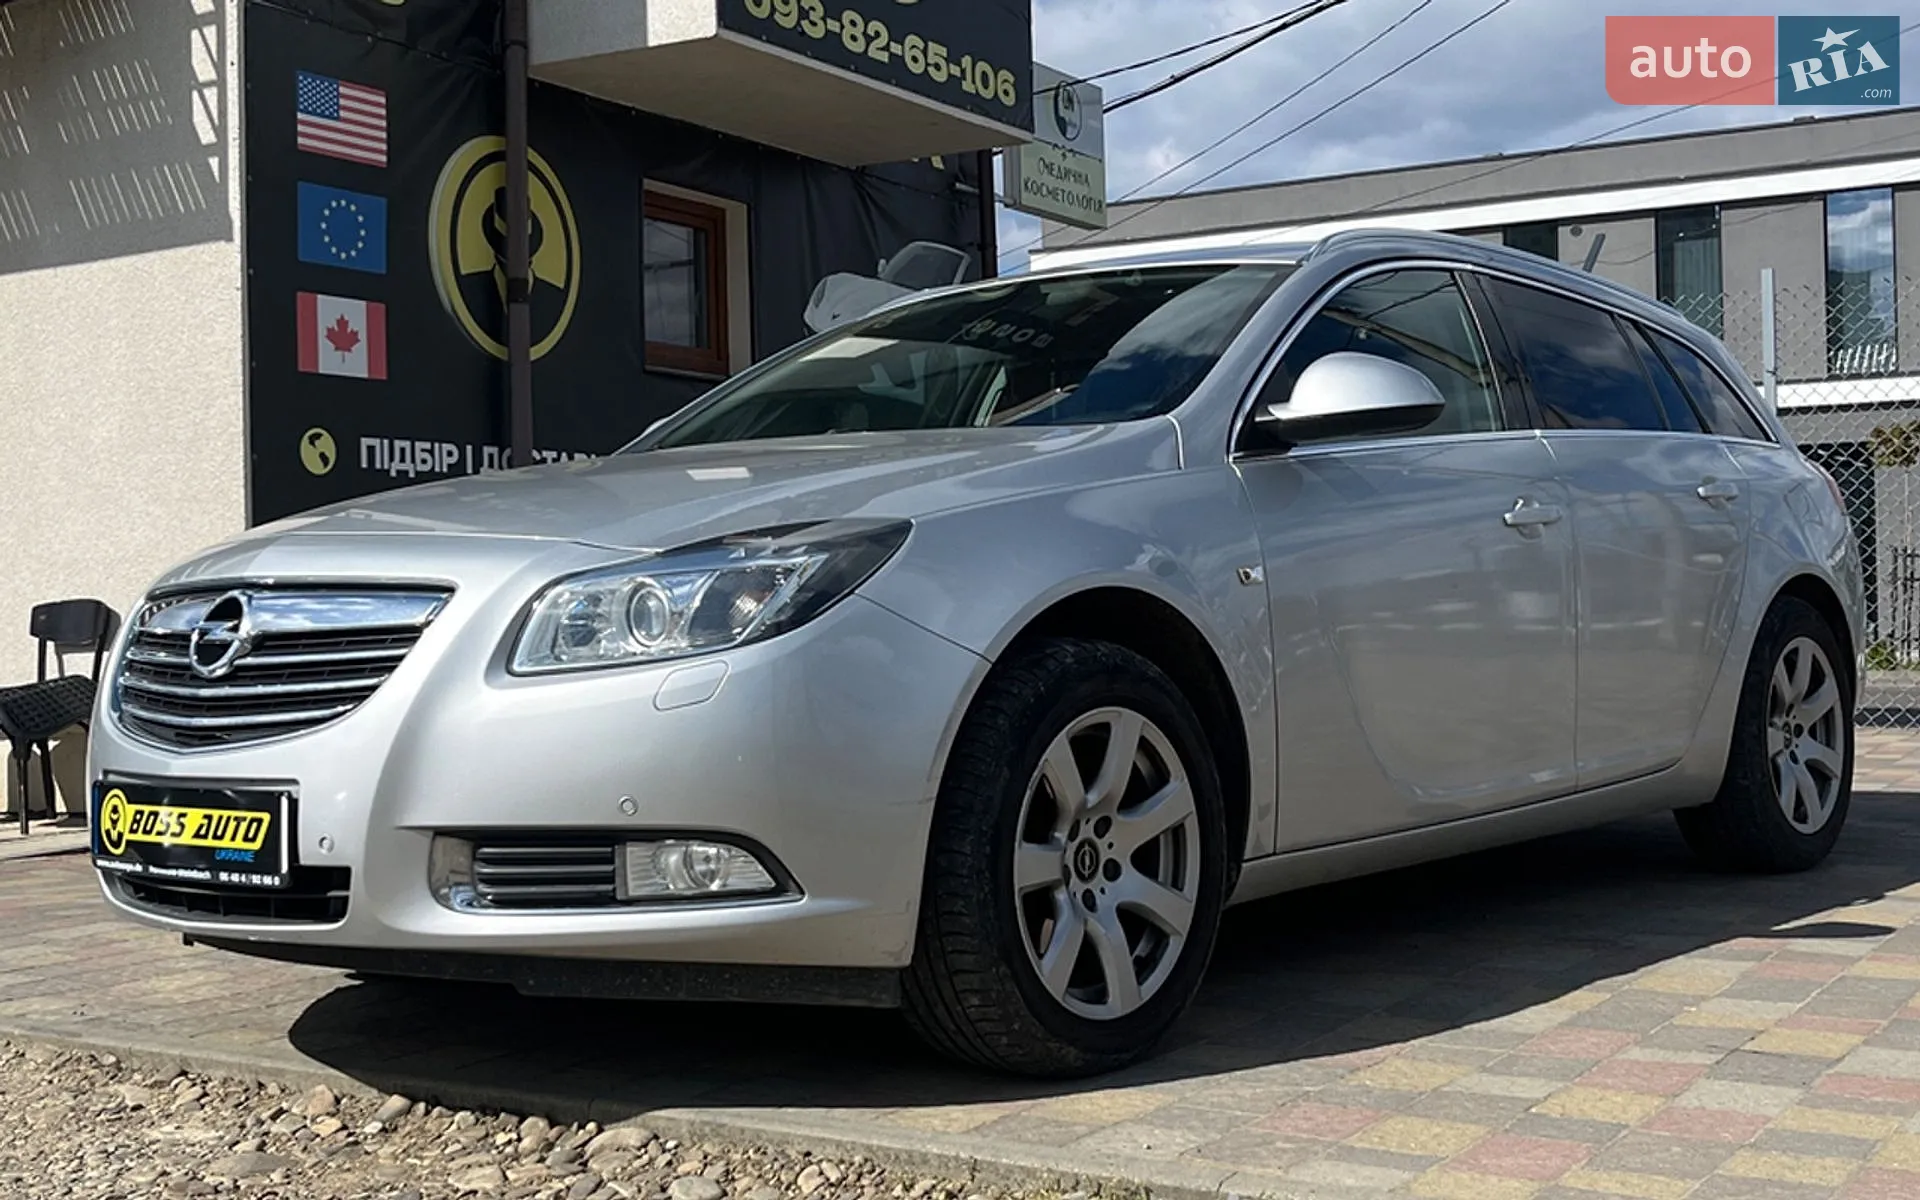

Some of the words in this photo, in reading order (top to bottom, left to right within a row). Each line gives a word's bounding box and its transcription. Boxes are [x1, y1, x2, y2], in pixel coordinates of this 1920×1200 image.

[359, 436, 459, 478] ПІДБІР
[128, 809, 188, 837] BOSS
[191, 814, 265, 844] AUTO
